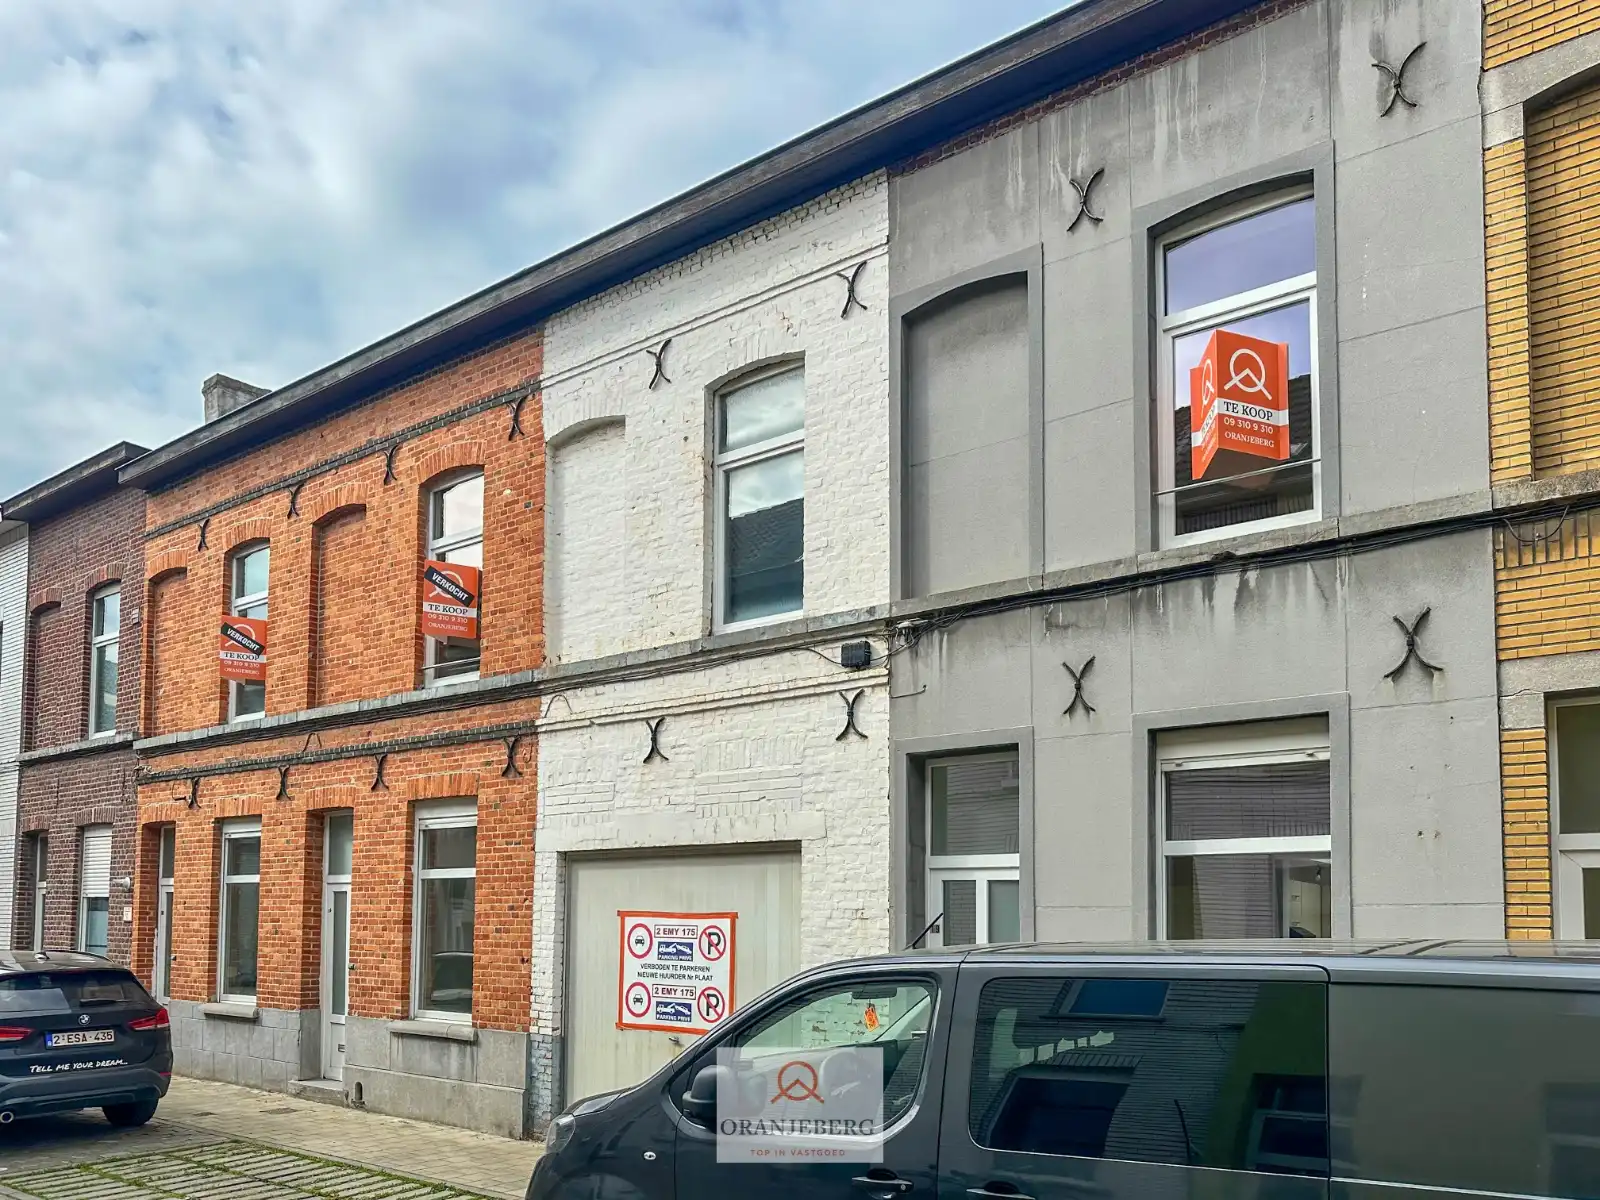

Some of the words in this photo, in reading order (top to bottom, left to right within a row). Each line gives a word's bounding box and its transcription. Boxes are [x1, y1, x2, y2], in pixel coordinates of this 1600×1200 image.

[1224, 401, 1239, 413] TE
[1242, 404, 1273, 420] KOOP
[1224, 417, 1235, 425] 09
[1237, 420, 1251, 429] 310
[1260, 425, 1273, 434] 310
[1224, 431, 1274, 447] ORANJEBERG
[432, 572, 468, 601] VERKOCHT
[442, 606, 468, 615] KOOP
[227, 628, 260, 651] VERKOCHT
[236, 653, 260, 661] KOOP
[682, 928, 695, 936] 175
[56, 1063, 70, 1071] ME
[73, 1061, 93, 1069] YOUR
